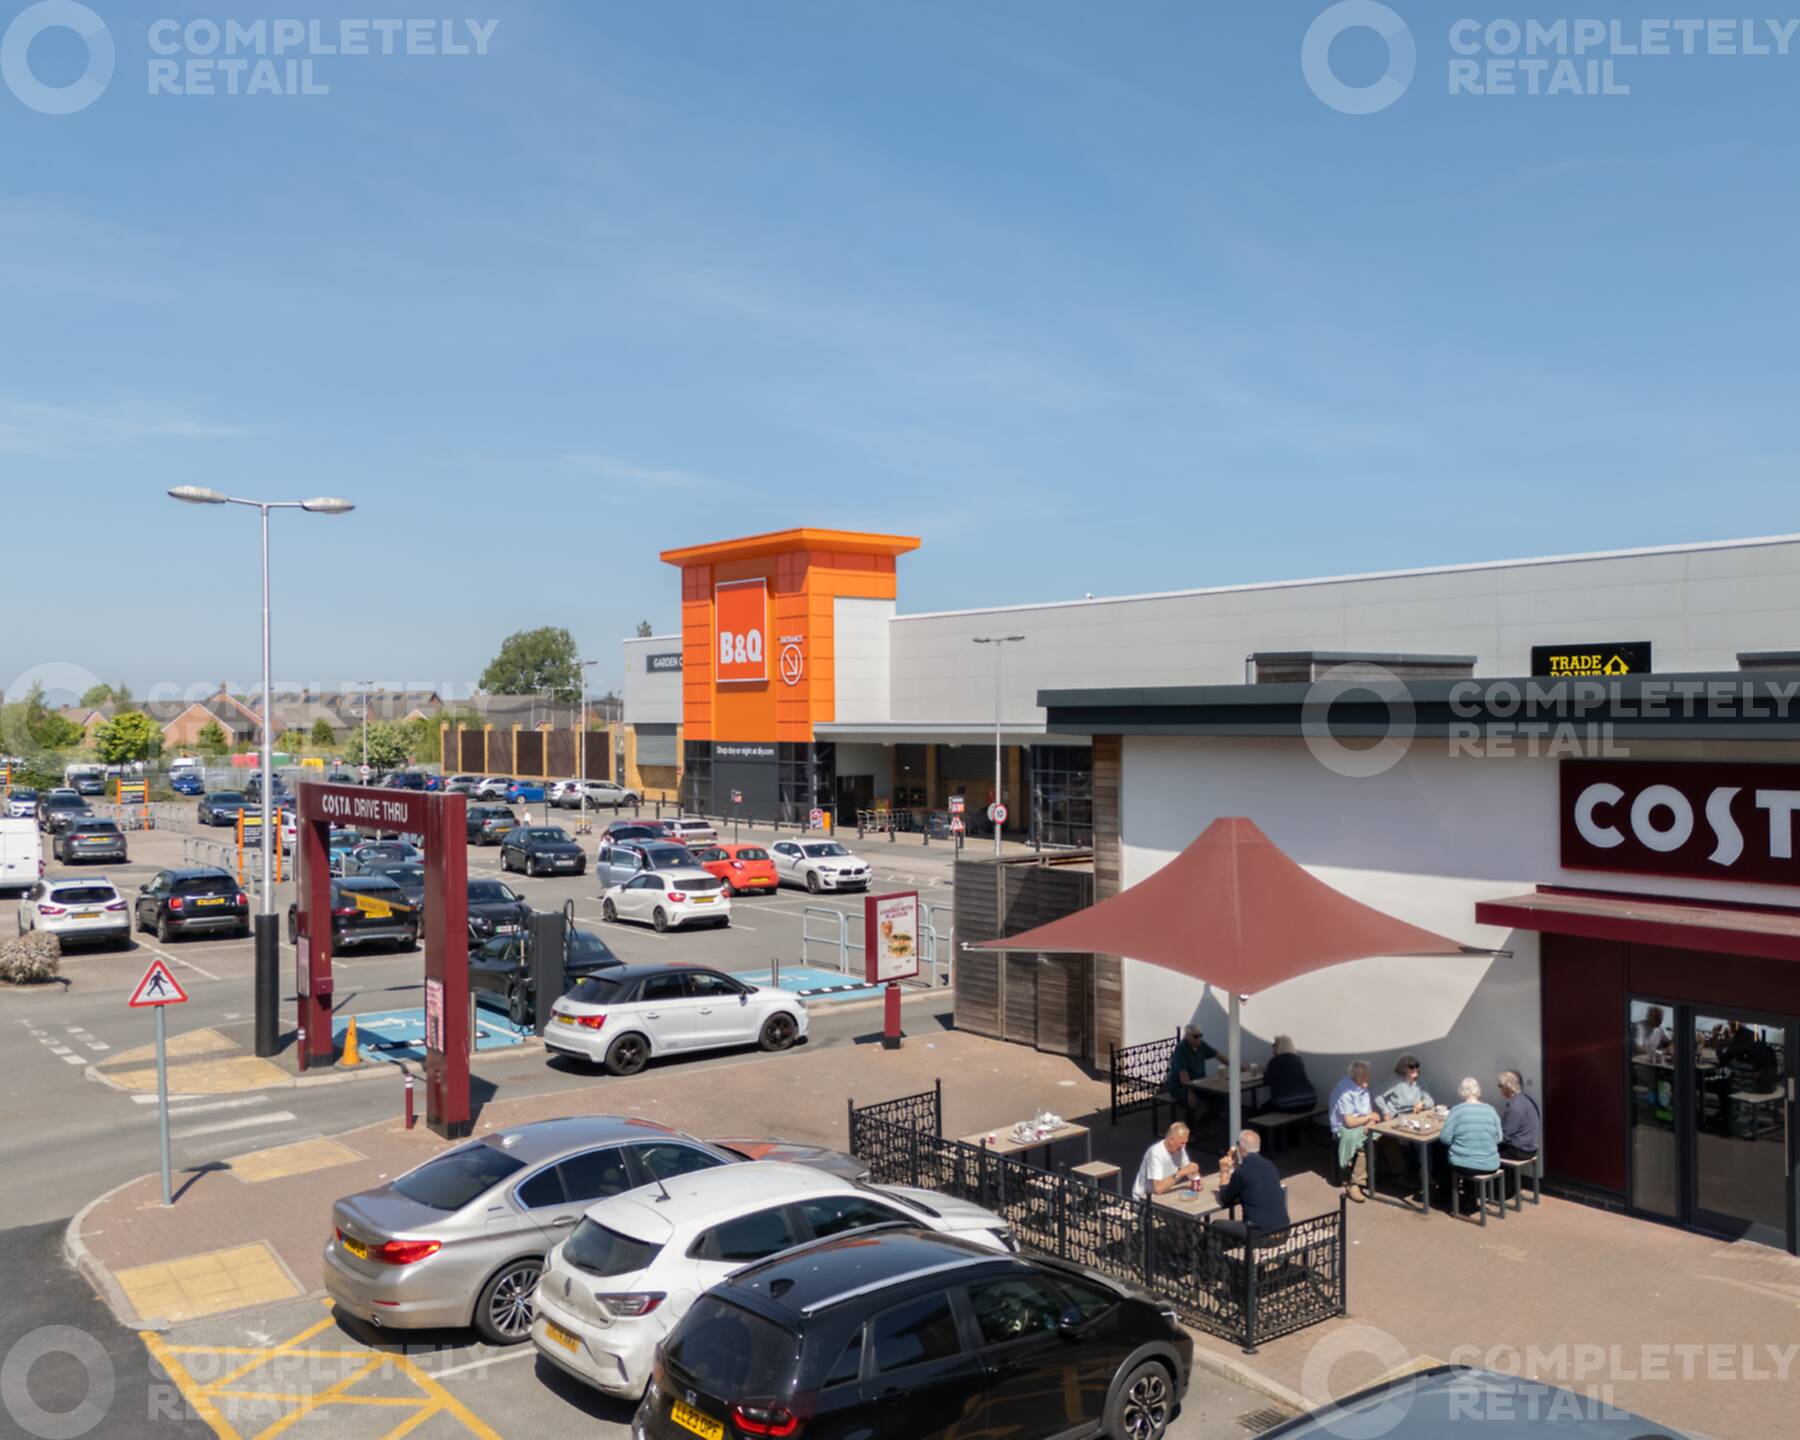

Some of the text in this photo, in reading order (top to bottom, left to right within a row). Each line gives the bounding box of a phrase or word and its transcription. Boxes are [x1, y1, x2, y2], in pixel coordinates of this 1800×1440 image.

[720, 629, 762, 664] B&Q
[653, 656, 678, 668] GARDEN
[1549, 655, 1602, 670] TRADE
[322, 794, 408, 823] COSTA DRIVE THRU
